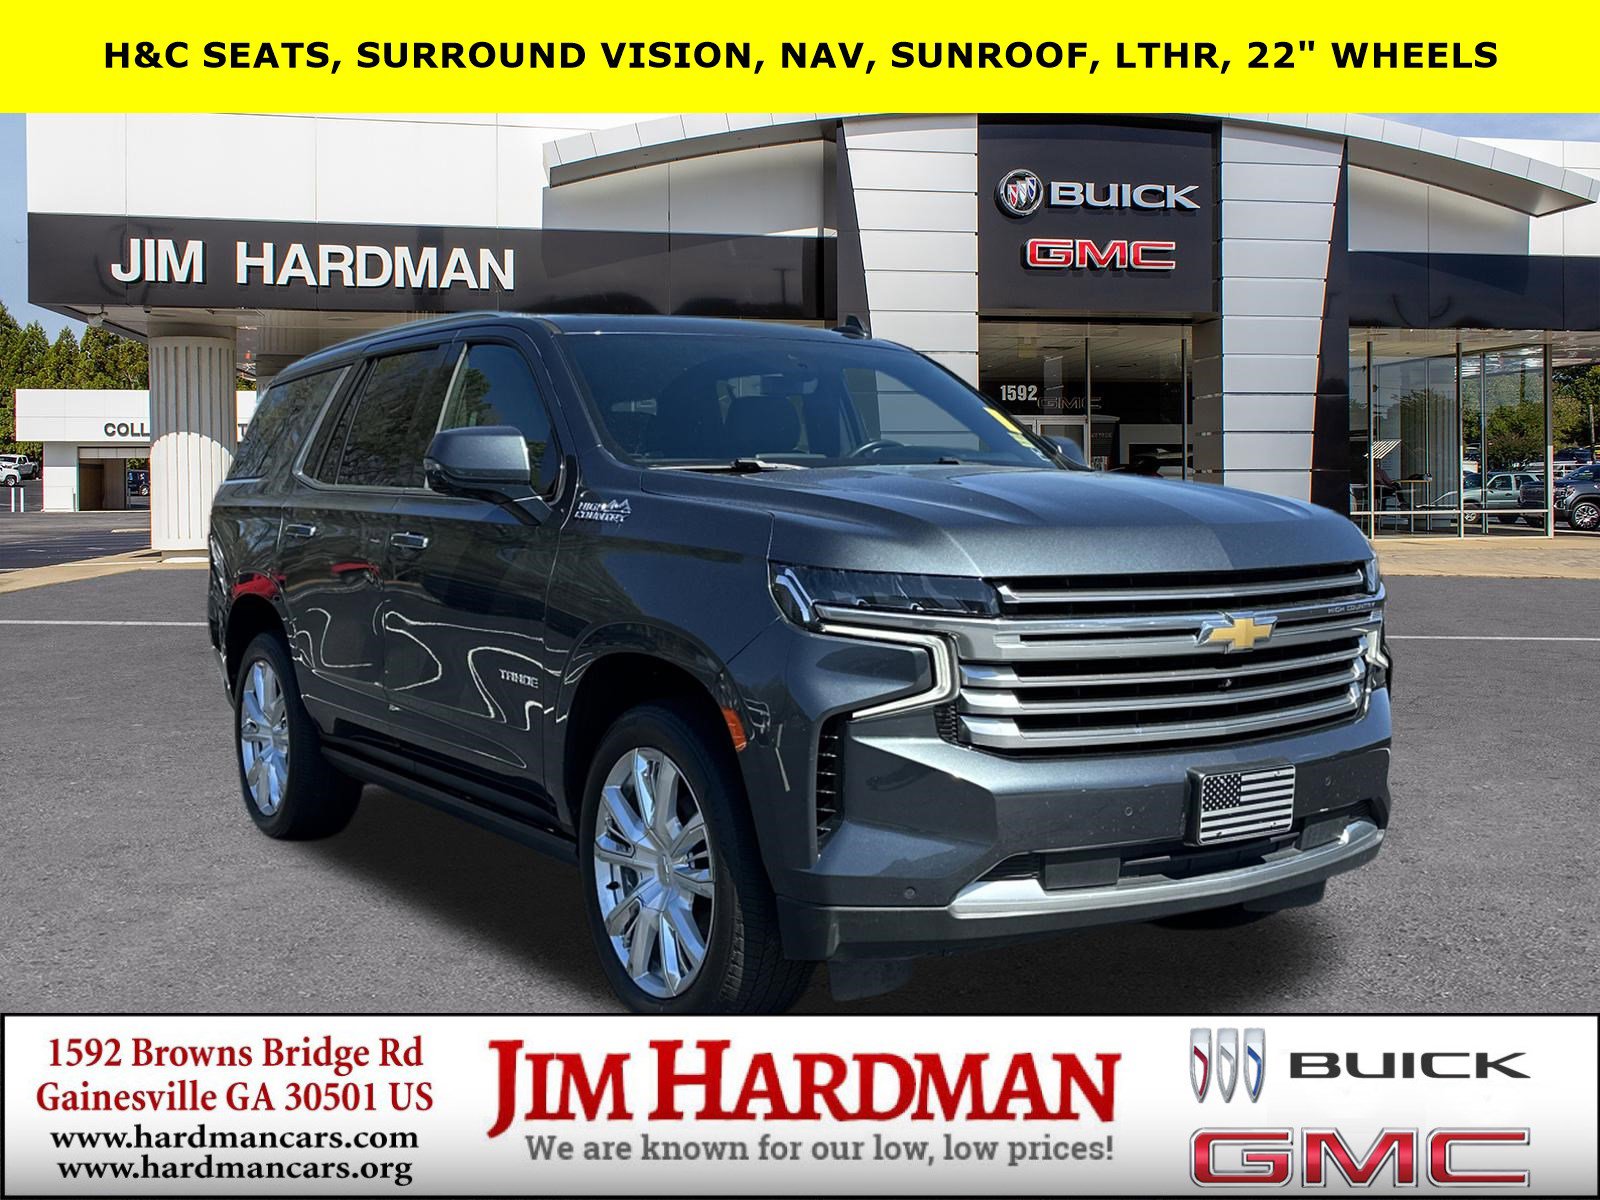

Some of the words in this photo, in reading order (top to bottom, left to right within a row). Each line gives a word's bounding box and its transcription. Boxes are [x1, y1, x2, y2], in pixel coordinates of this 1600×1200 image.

[1050, 181, 1201, 209] BUICK
[111, 238, 204, 283] JIM
[236, 241, 515, 291] HARDMAN
[1026, 238, 1176, 270] GMC
[1000, 384, 1038, 401] 1592
[104, 422, 150, 437] COLL
[499, 668, 539, 689] TAHOE
